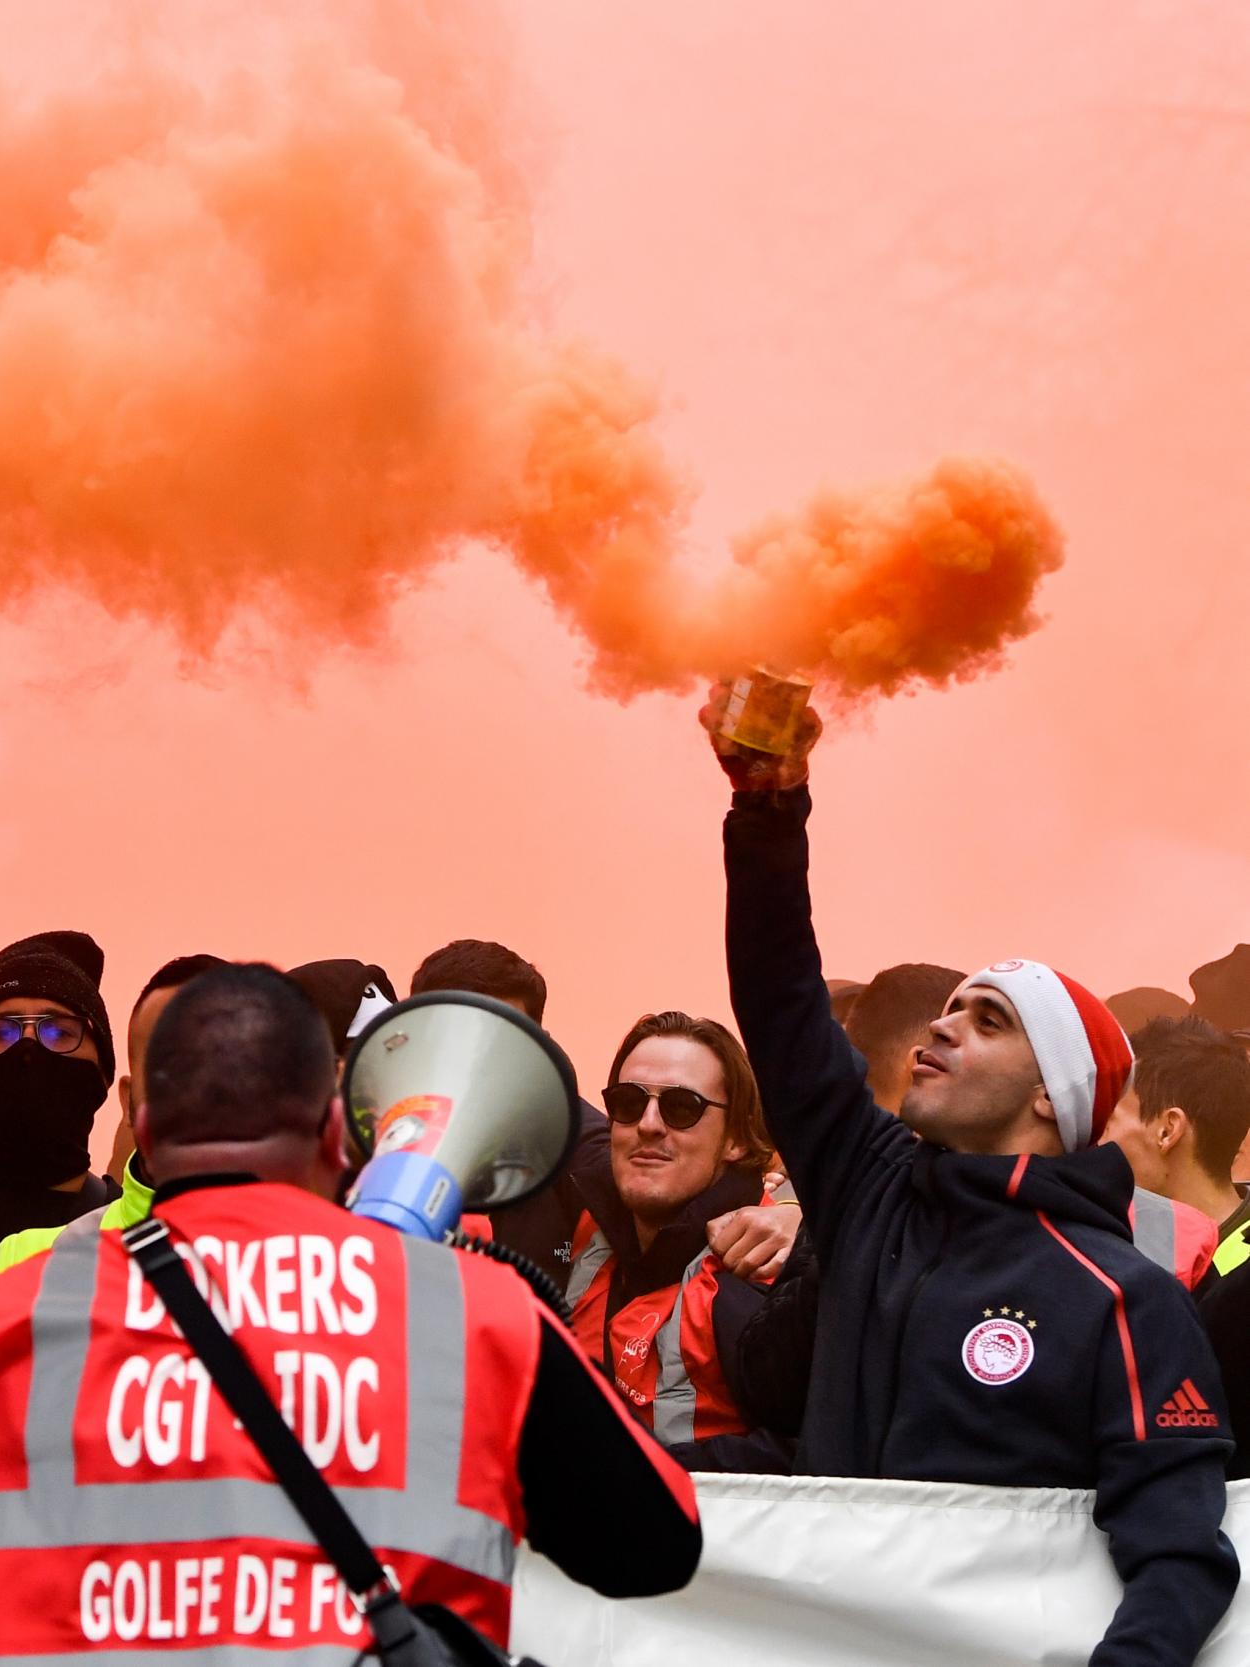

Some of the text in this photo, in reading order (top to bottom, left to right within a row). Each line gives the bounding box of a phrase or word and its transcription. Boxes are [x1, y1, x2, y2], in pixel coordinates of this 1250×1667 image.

[106, 1352, 212, 1468] CGT
[1155, 1409, 1219, 1428] adidas
[80, 1553, 401, 1642] GOLFE DE FO
